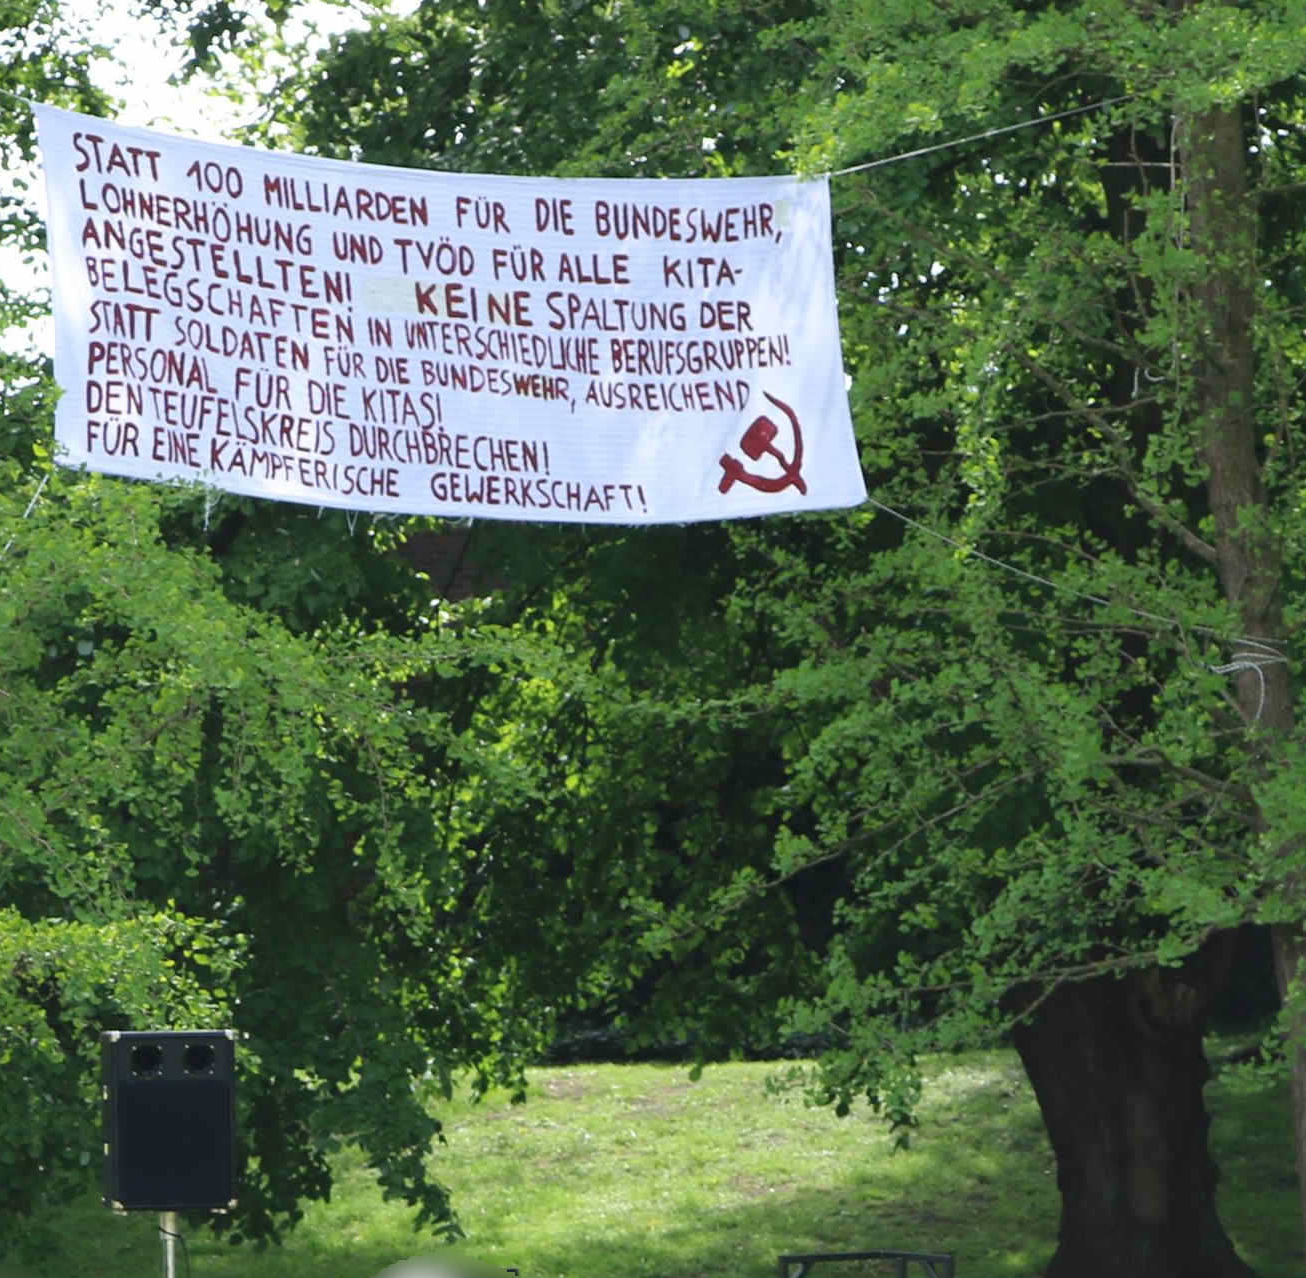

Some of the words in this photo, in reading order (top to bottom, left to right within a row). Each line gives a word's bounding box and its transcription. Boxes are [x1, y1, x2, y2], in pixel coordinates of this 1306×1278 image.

[73, 132, 161, 180] STATT
[187, 161, 243, 199] 100
[264, 174, 428, 226] MILLIARDEN
[456, 196, 510, 233] FÜR
[535, 198, 574, 236] DIE
[595, 201, 783, 244] BUNDESWEHR,
[79, 179, 312, 255] LOHNERHÖHUNG
[333, 232, 382, 264] UND
[394, 236, 474, 276] TVÖD
[492, 244, 545, 282] FÜR
[558, 253, 629, 285] ALLE
[663, 255, 743, 289] KITA-
[81, 218, 353, 313] ANGESTELLTEN!
[415, 281, 533, 327] KEINE
[545, 291, 686, 333] SPALTUNG
[699, 301, 754, 332] DER
[85, 256, 355, 344] BELEGSCHAFTEN
[367, 317, 393, 349] IN
[404, 319, 600, 376] UNTERSCHIEDLICHE
[610, 333, 792, 377] BERUFSGRUPPEN!
[87, 341, 218, 394] PERSONAL
[234, 367, 292, 411] FÜR
[308, 380, 352, 420] DIE
[362, 389, 445, 432] KITAS!
[88, 300, 161, 342] STATT
[175, 315, 310, 371] SOLDATEN
[324, 345, 365, 379] FÜR
[375, 355, 410, 386] DIE
[421, 358, 576, 414] BUNDESWEHR,
[585, 380, 751, 412] AUSREICHEND
[86, 380, 144, 415] DEN
[148, 387, 335, 456] TEUFELSKREIS
[349, 421, 551, 475] DURCHBRECHEN!
[87, 419, 139, 457] FÜR
[152, 427, 202, 468] EINE
[210, 437, 400, 499] KÄMPFERISCHE
[430, 472, 648, 513] GEWERKSCHAFT!
